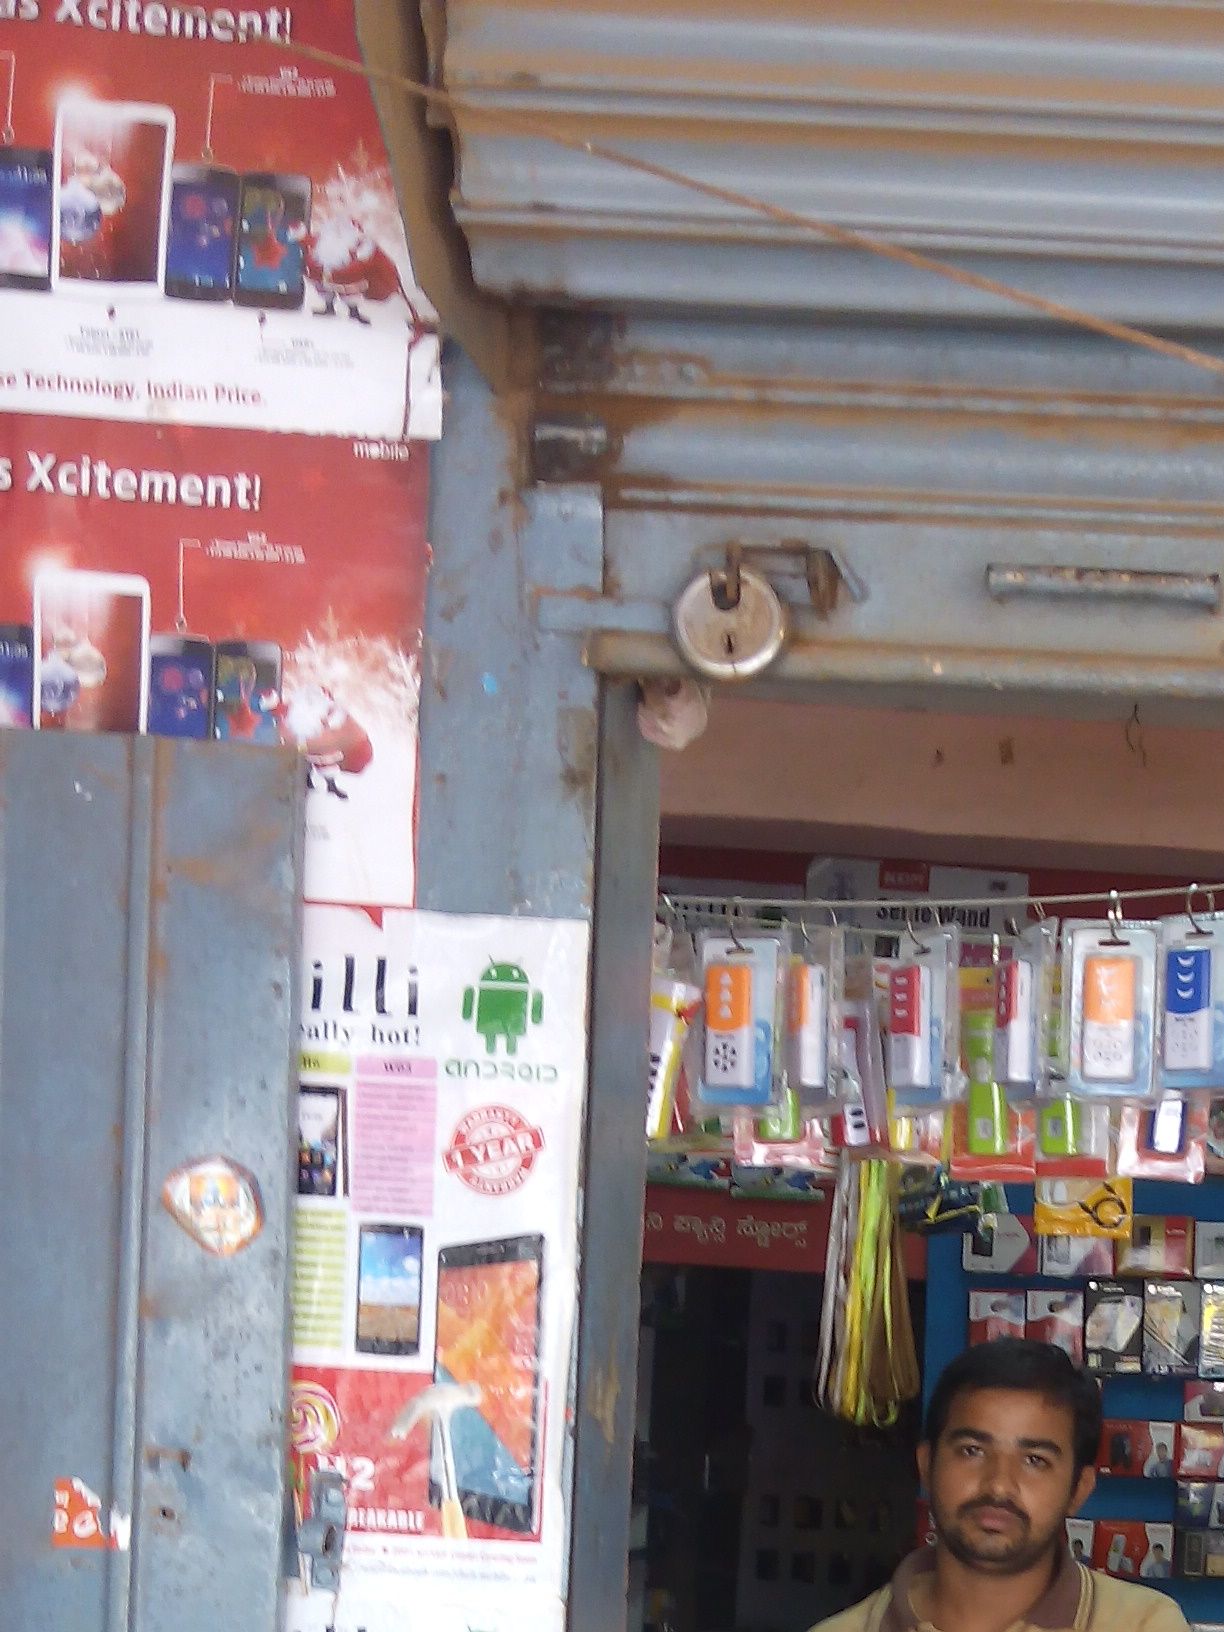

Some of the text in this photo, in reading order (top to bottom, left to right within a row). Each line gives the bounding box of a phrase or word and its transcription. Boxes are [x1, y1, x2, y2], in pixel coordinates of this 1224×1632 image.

[24, 369, 140, 401] Technology,
[146, 380, 208, 402] Indian
[214, 386, 267, 407] Price.
[26, 449, 262, 512] Xcitement!
[371, 1023, 421, 1047] hot!
[468, 1129, 536, 1165] YEAR
